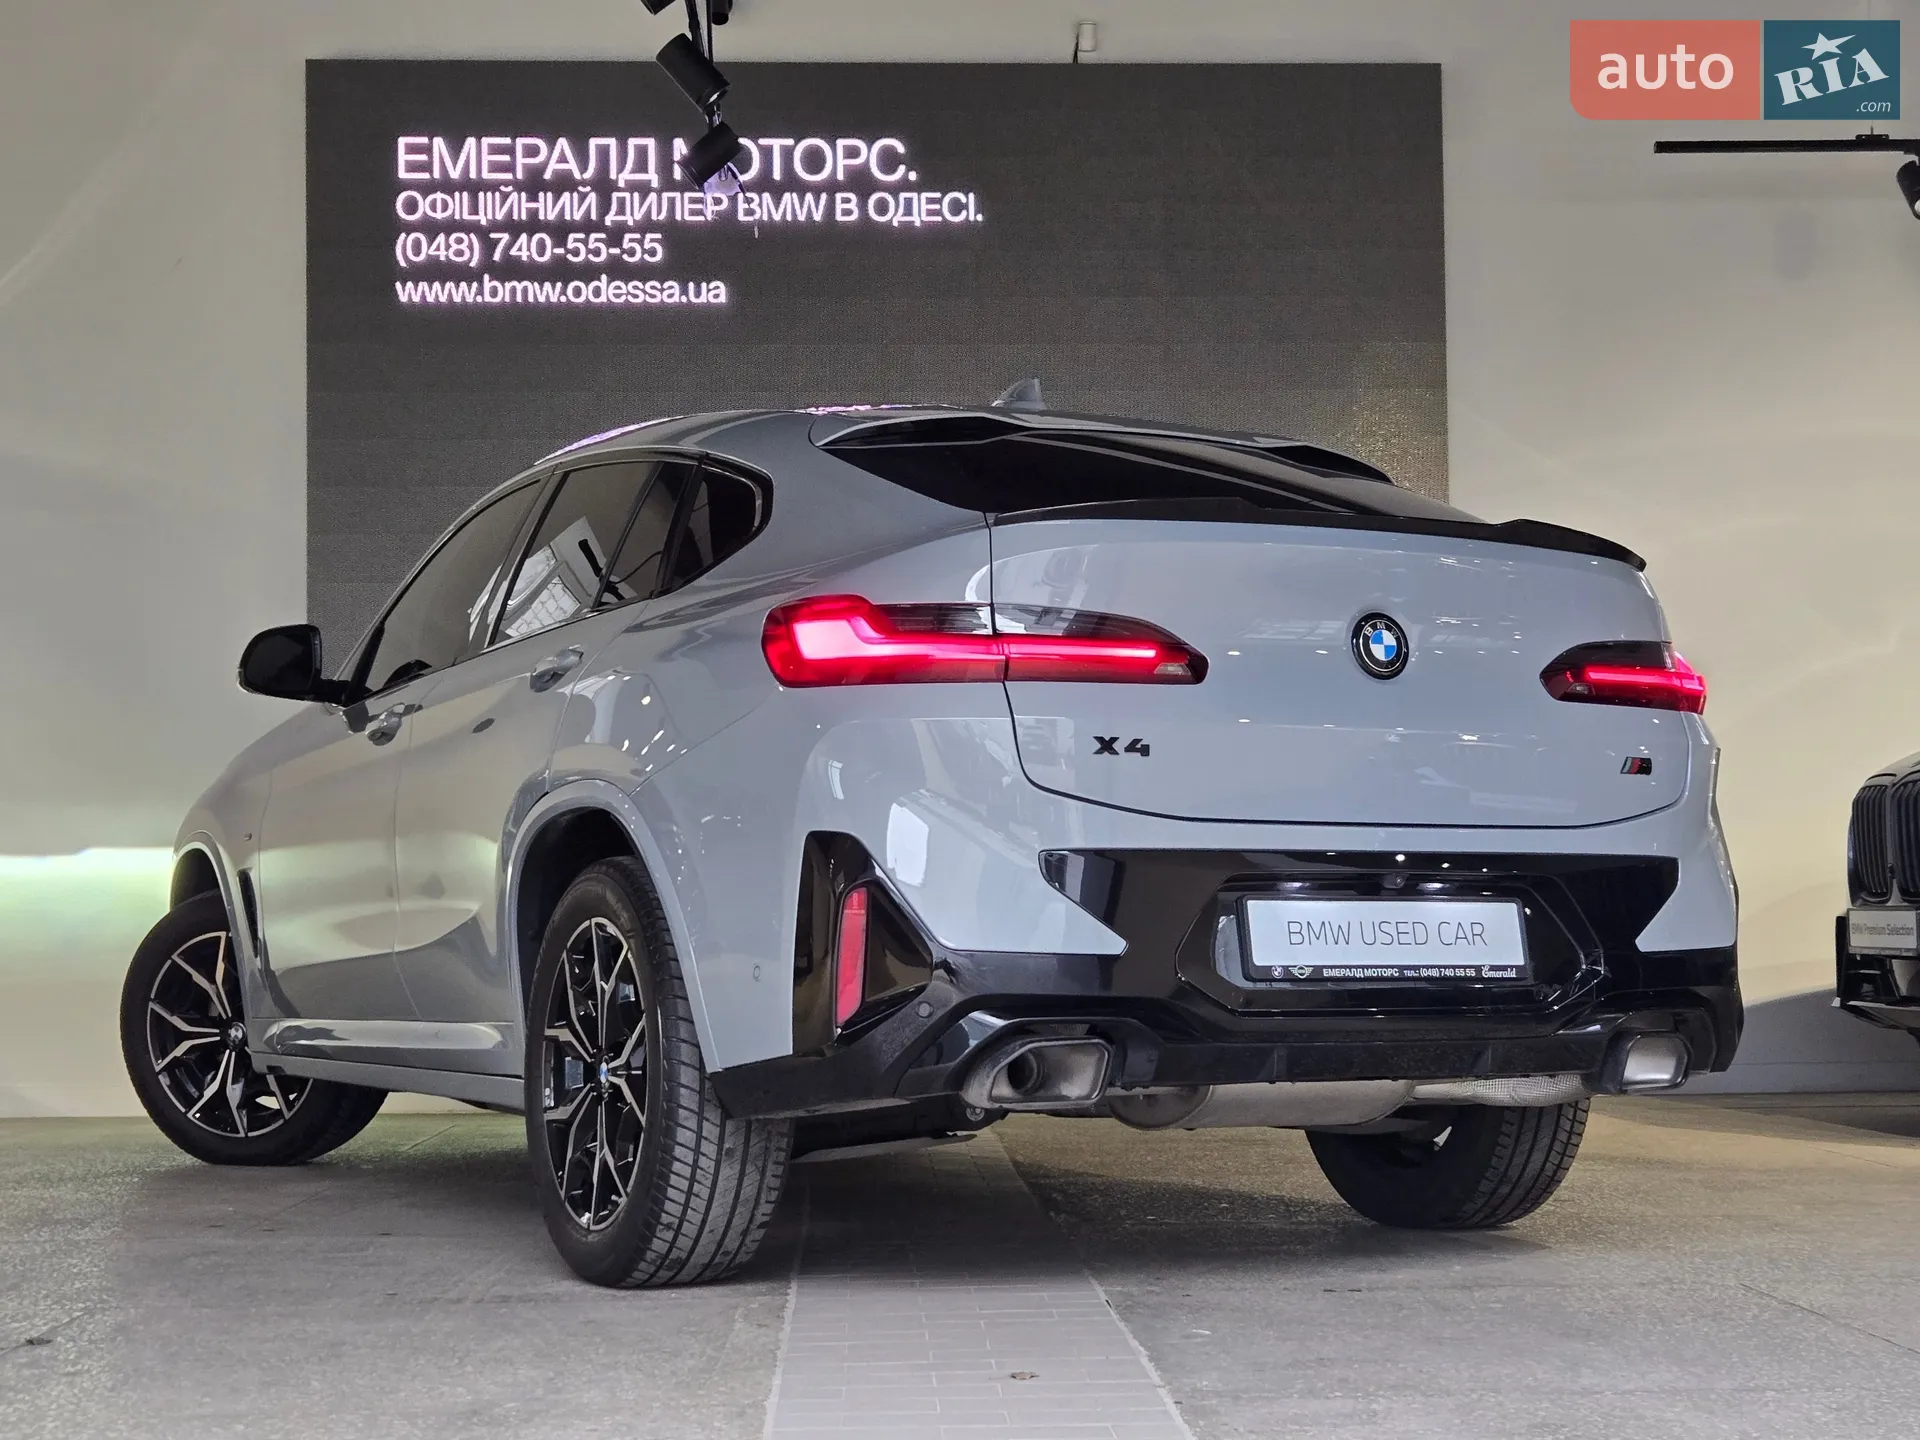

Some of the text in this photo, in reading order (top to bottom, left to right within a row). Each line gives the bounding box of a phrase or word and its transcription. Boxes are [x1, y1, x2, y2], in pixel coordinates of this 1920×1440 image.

[397, 136, 659, 188] ЕМЕРАЛД
[395, 186, 597, 225] ОФІЦІЙНИЙ
[604, 191, 729, 226] ДИЛЕР
[867, 191, 984, 227] ОДЕСІ.
[395, 232, 663, 267] (048) 740-55-55
[395, 274, 727, 304] www.bmw.odessa.ua
[1364, 621, 1399, 638] BMW
[1287, 920, 1488, 946] BMW USED CAR
[1323, 968, 1364, 978] ЕМЕРАЛД
[1364, 968, 1399, 977] МОТОРС
[1440, 968, 1454, 977] 740
[1455, 968, 1465, 977] 55
[1465, 968, 1476, 977] 55
[1482, 964, 1517, 978] Emerald
